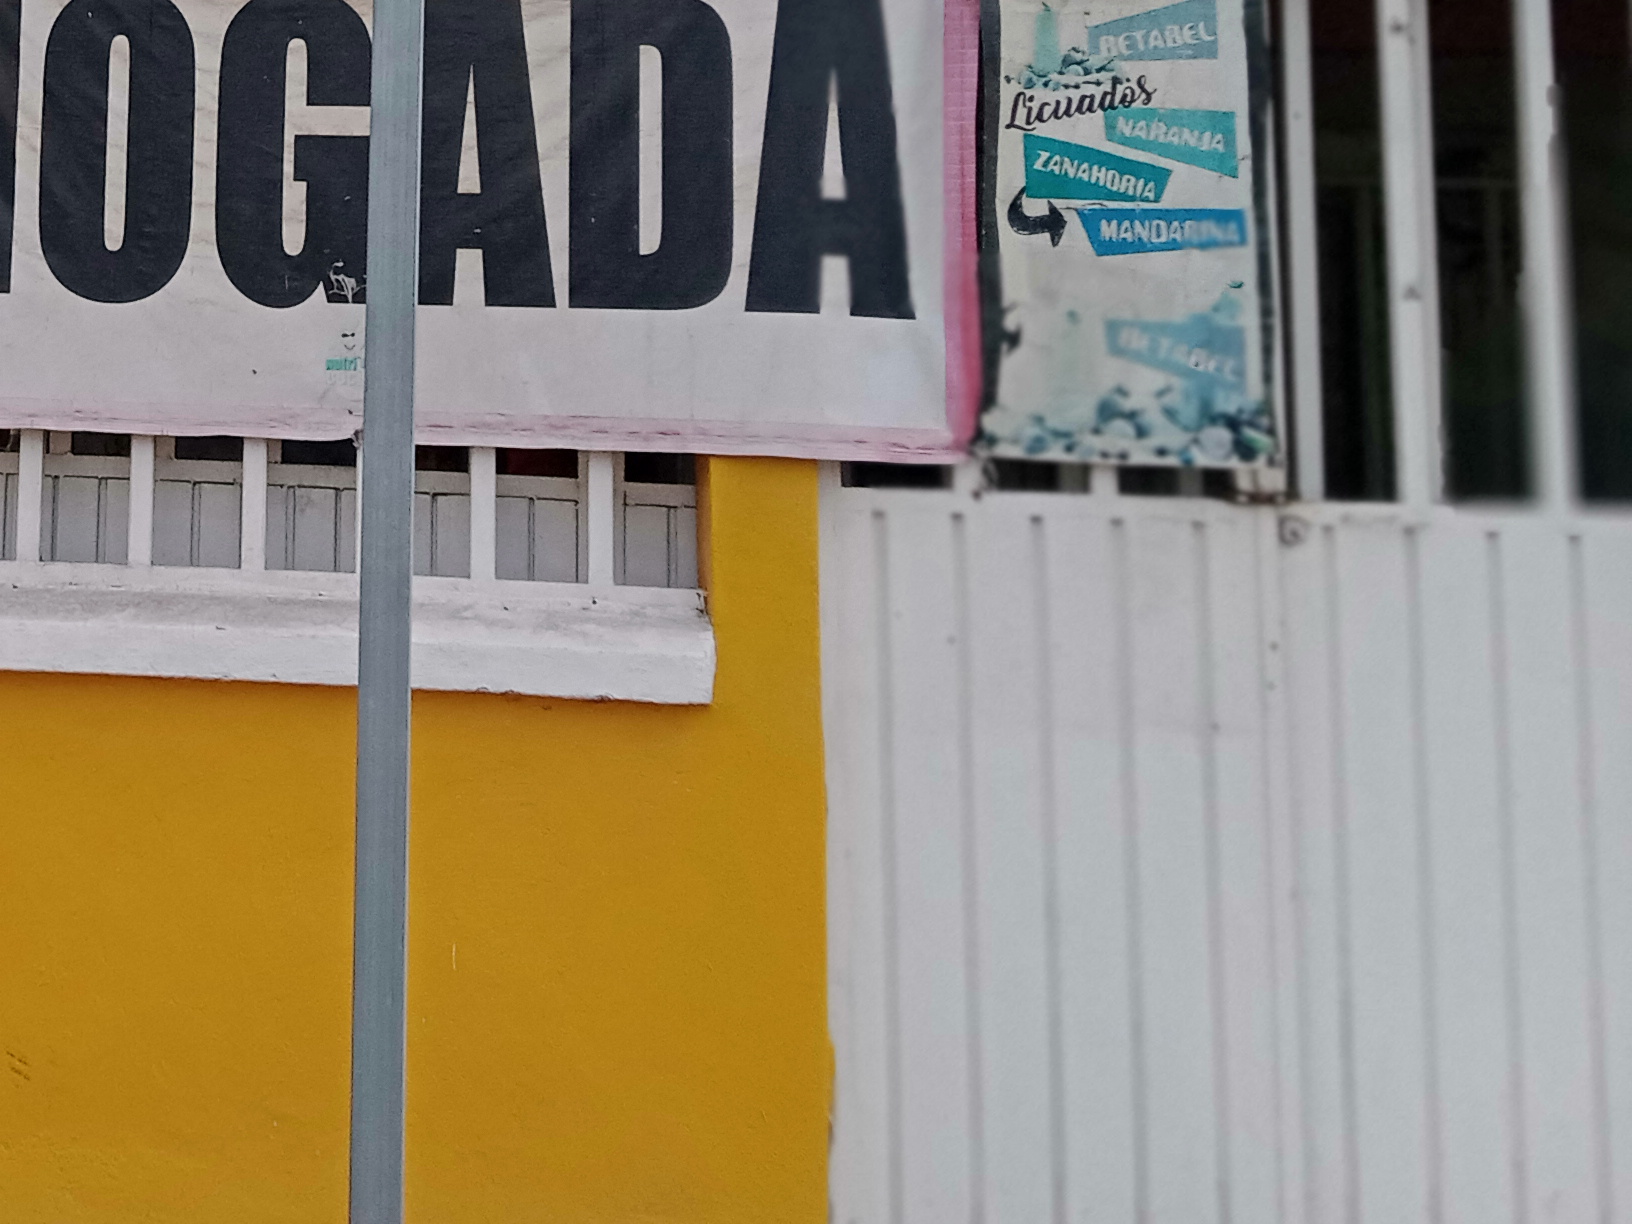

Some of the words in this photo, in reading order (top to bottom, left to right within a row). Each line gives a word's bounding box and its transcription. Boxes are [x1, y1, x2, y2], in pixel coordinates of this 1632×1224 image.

[1098, 20, 1217, 56] BETABEL
[1004, 74, 1157, 132] Licuados
[1115, 115, 1226, 153] NARANJA
[1033, 149, 1157, 201] ZANAHORIA
